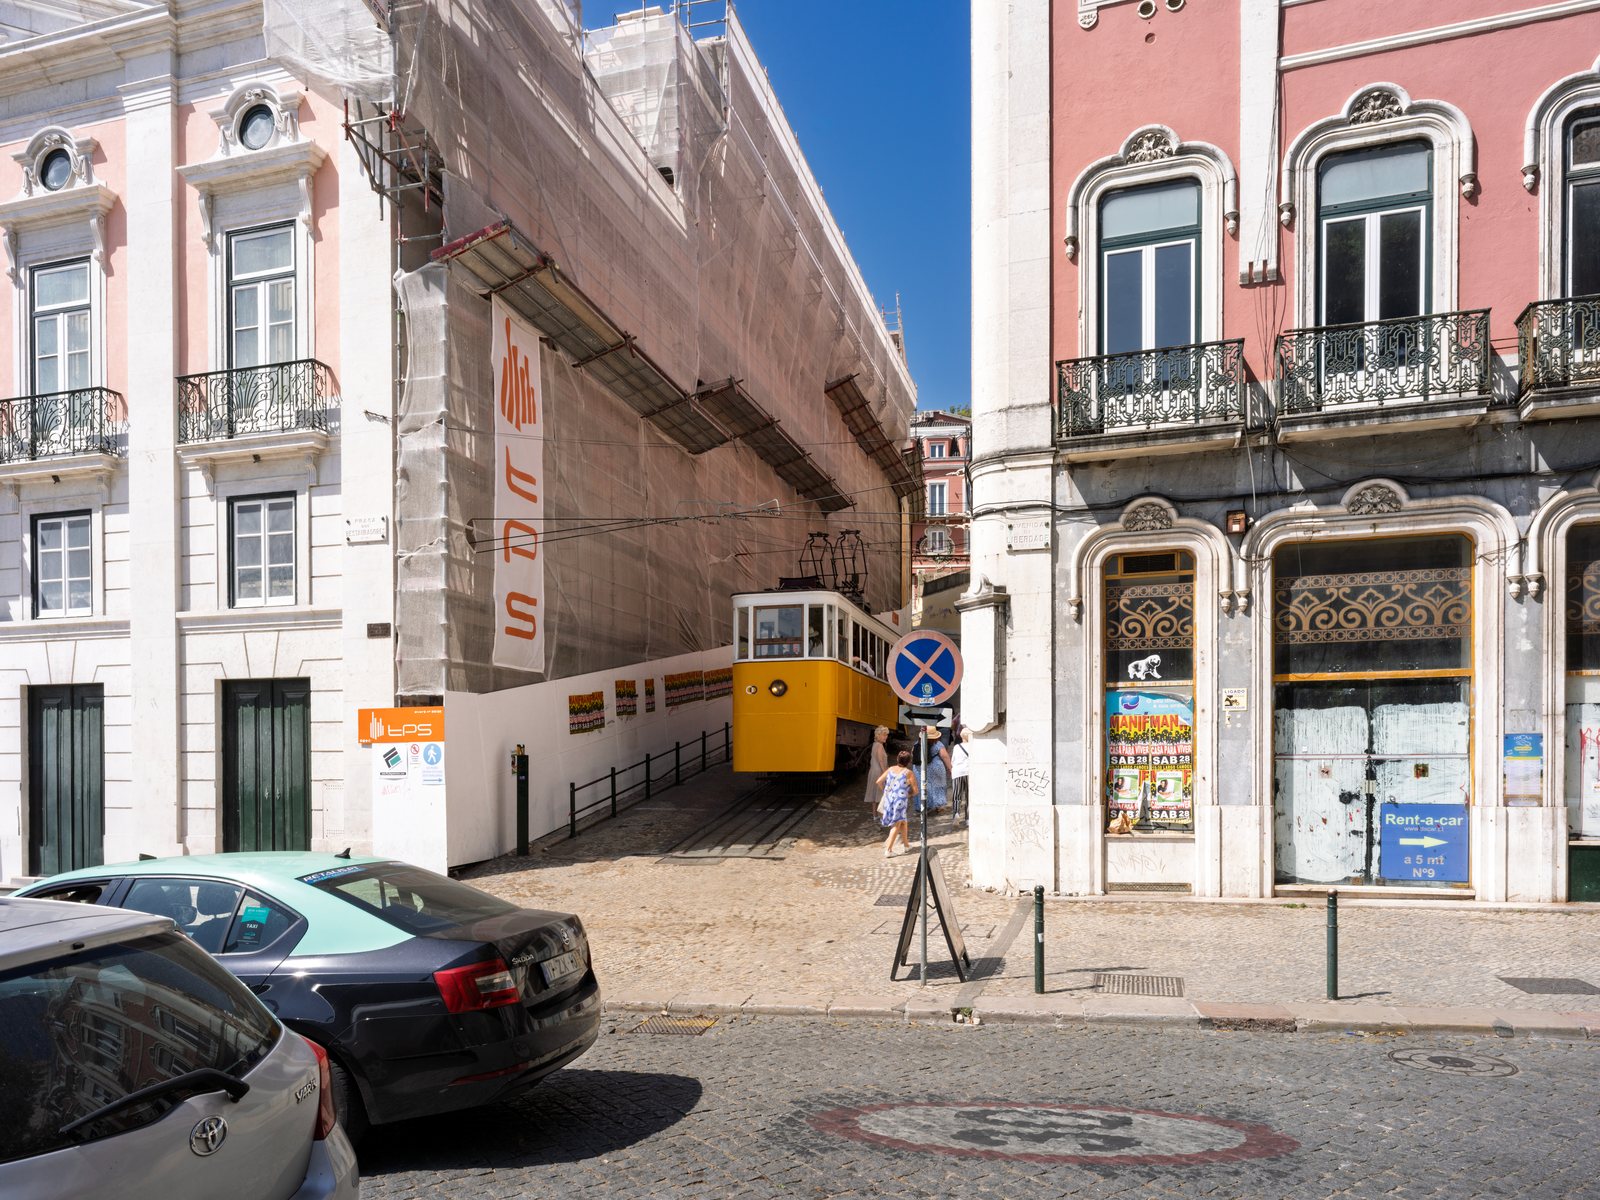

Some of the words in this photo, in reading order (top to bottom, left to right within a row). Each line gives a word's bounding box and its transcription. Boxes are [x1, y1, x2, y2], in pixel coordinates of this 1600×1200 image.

[1006, 534, 1050, 544] LIBERDADE
[1150, 714, 1187, 732] MAN
[1122, 746, 1135, 755] PARA
[1135, 745, 1149, 754] VIVER
[1151, 745, 1163, 755] CASA
[1164, 746, 1176, 755] PARA
[1177, 744, 1192, 754] VIVER
[1110, 756, 1135, 765] SAB
[1152, 756, 1178, 765] SAB
[1152, 810, 1178, 819] SAB
[1385, 813, 1464, 826] Rent-a-car
[1403, 856, 1412, 864] a
[1415, 855, 1423, 865] 5
[1427, 855, 1445, 865] mt
